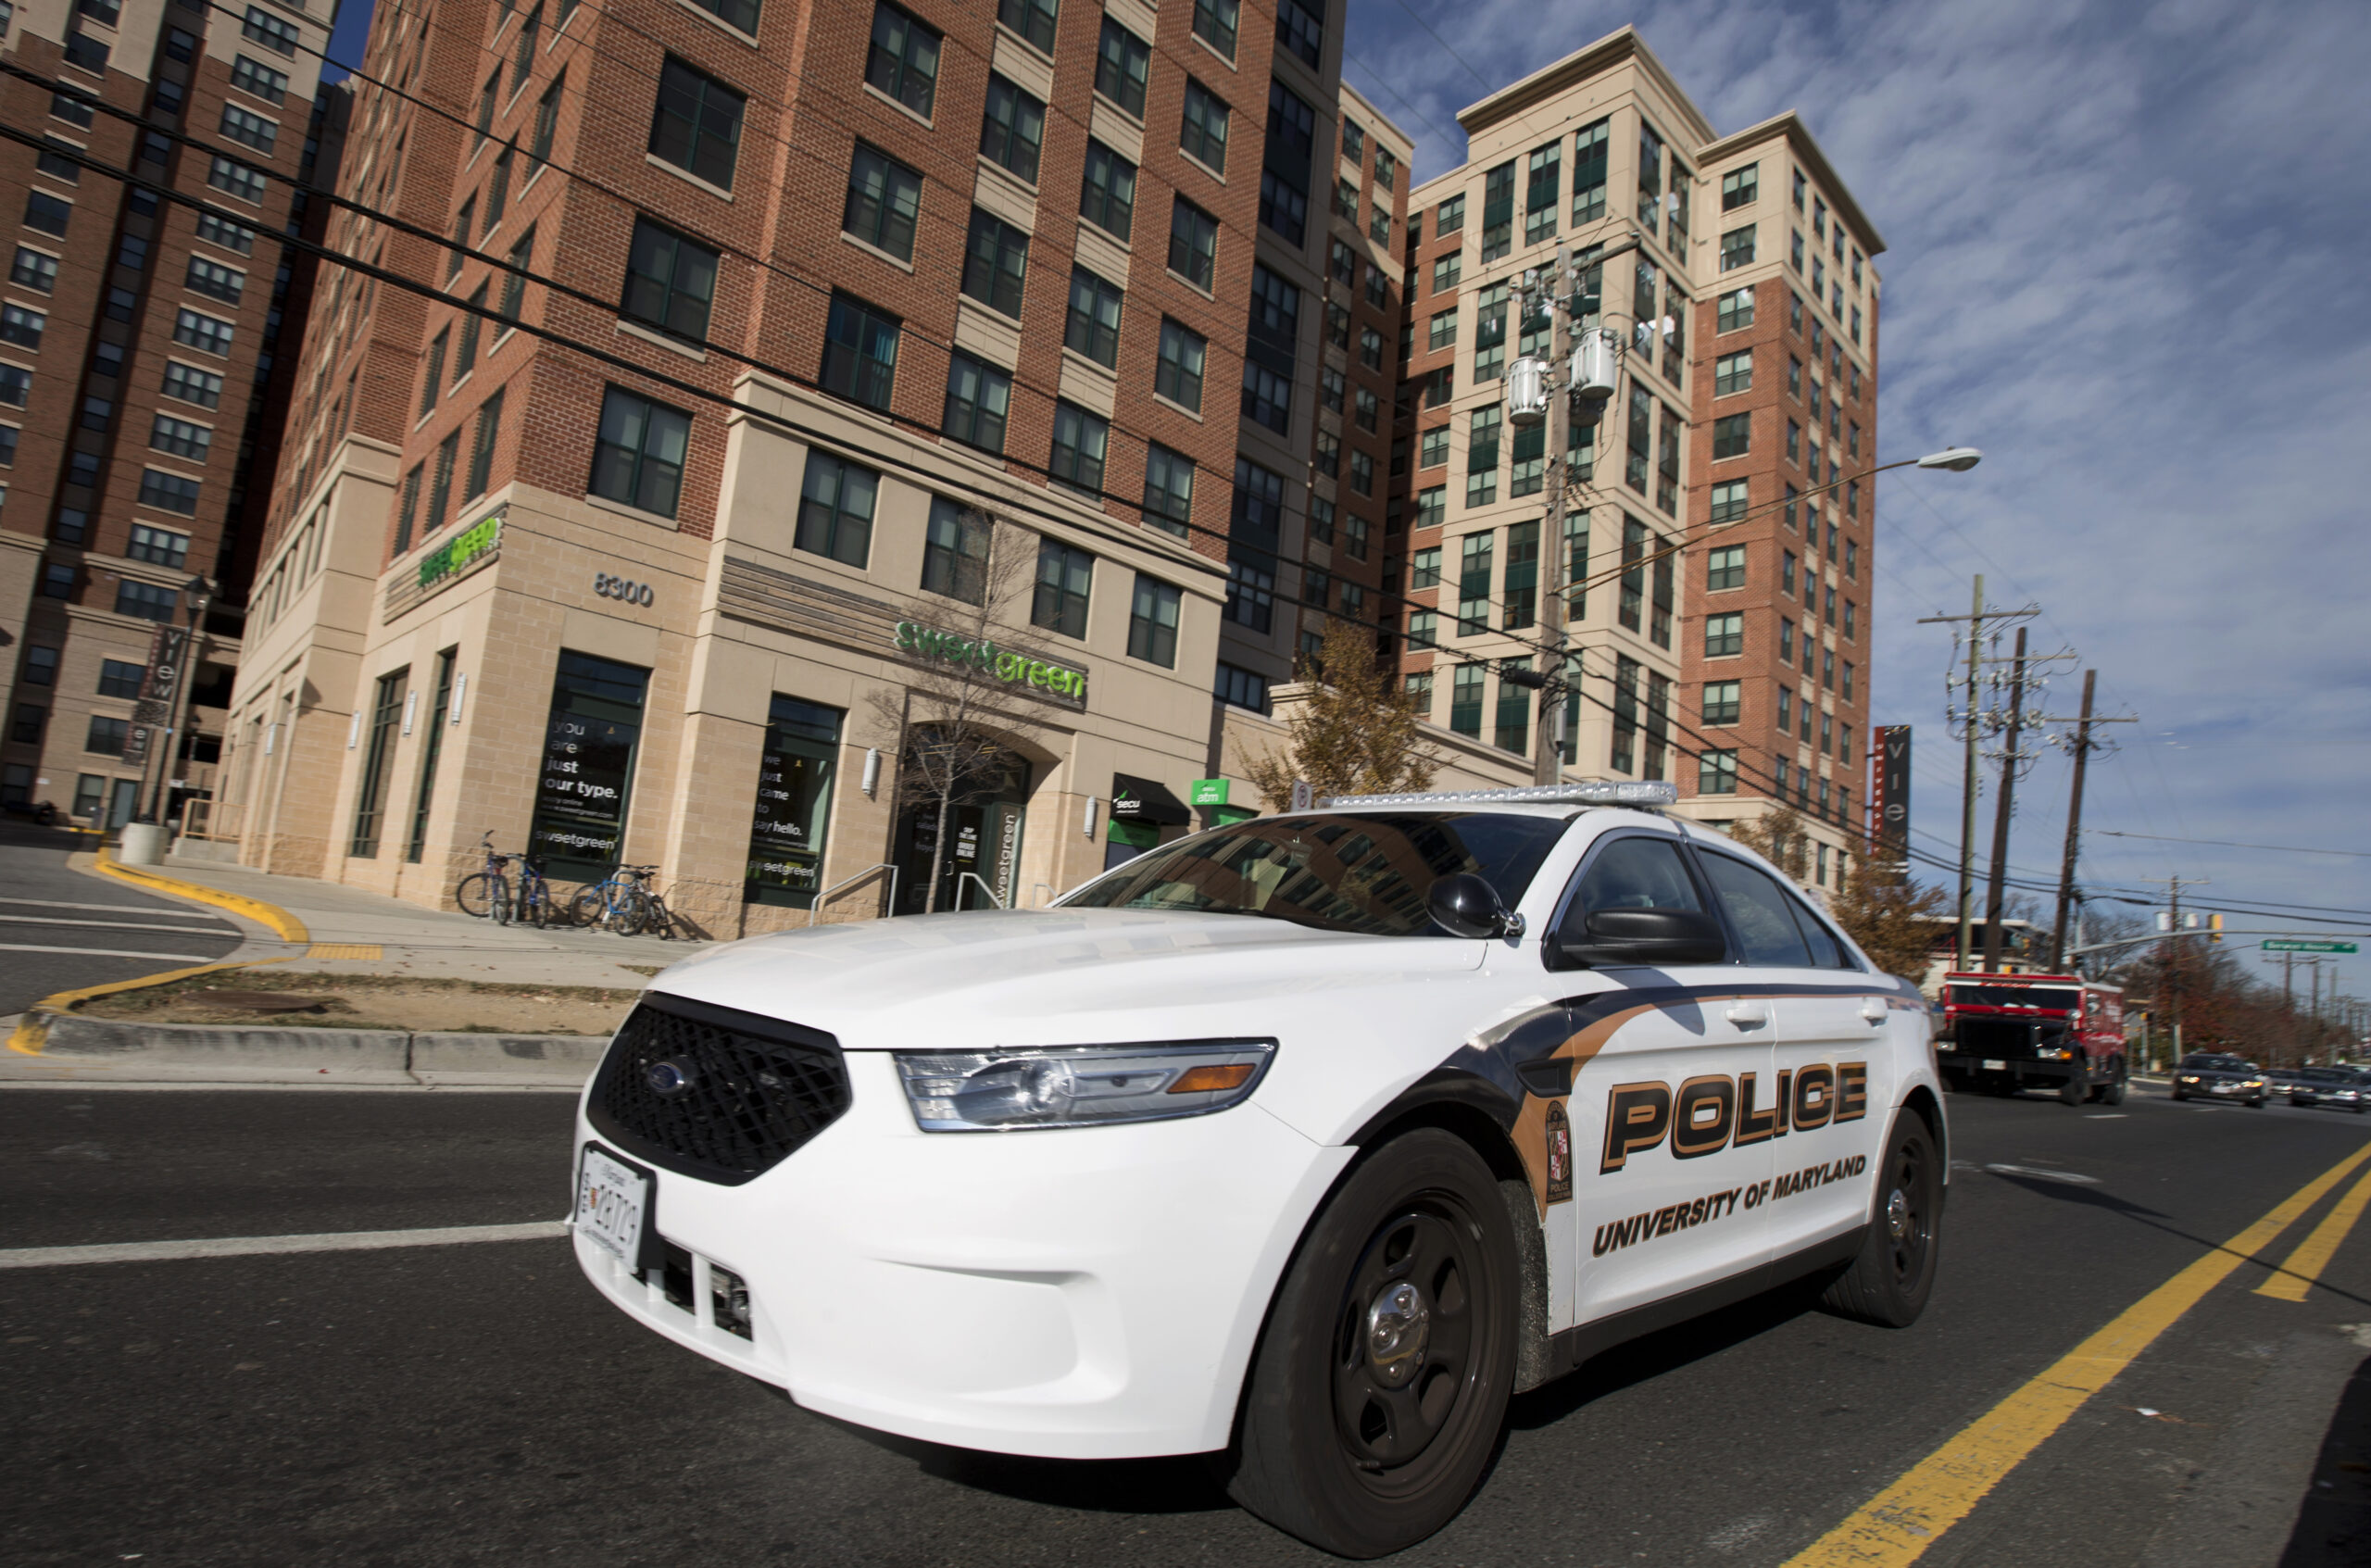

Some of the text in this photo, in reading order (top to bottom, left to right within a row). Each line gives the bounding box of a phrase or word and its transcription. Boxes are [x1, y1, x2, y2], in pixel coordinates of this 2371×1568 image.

[593, 571, 653, 607] 8300
[893, 621, 1085, 697] sweetgreen
[554, 721, 585, 736] you
[551, 740, 578, 754] are
[546, 756, 579, 773] just
[764, 755, 781, 765] we
[760, 770, 783, 783] just
[545, 778, 619, 799] our type.
[759, 787, 789, 801] came
[1116, 799, 1141, 809] secu
[1196, 792, 1219, 803] atm
[757, 804, 770, 814] to
[754, 821, 803, 836] say hello.
[534, 830, 616, 850] sweetgreen
[748, 859, 816, 877] sweetgreen
[1599, 1061, 1868, 1175] POLICE
[1592, 1154, 1866, 1258] UNIVERSITY OF MARYLAND
